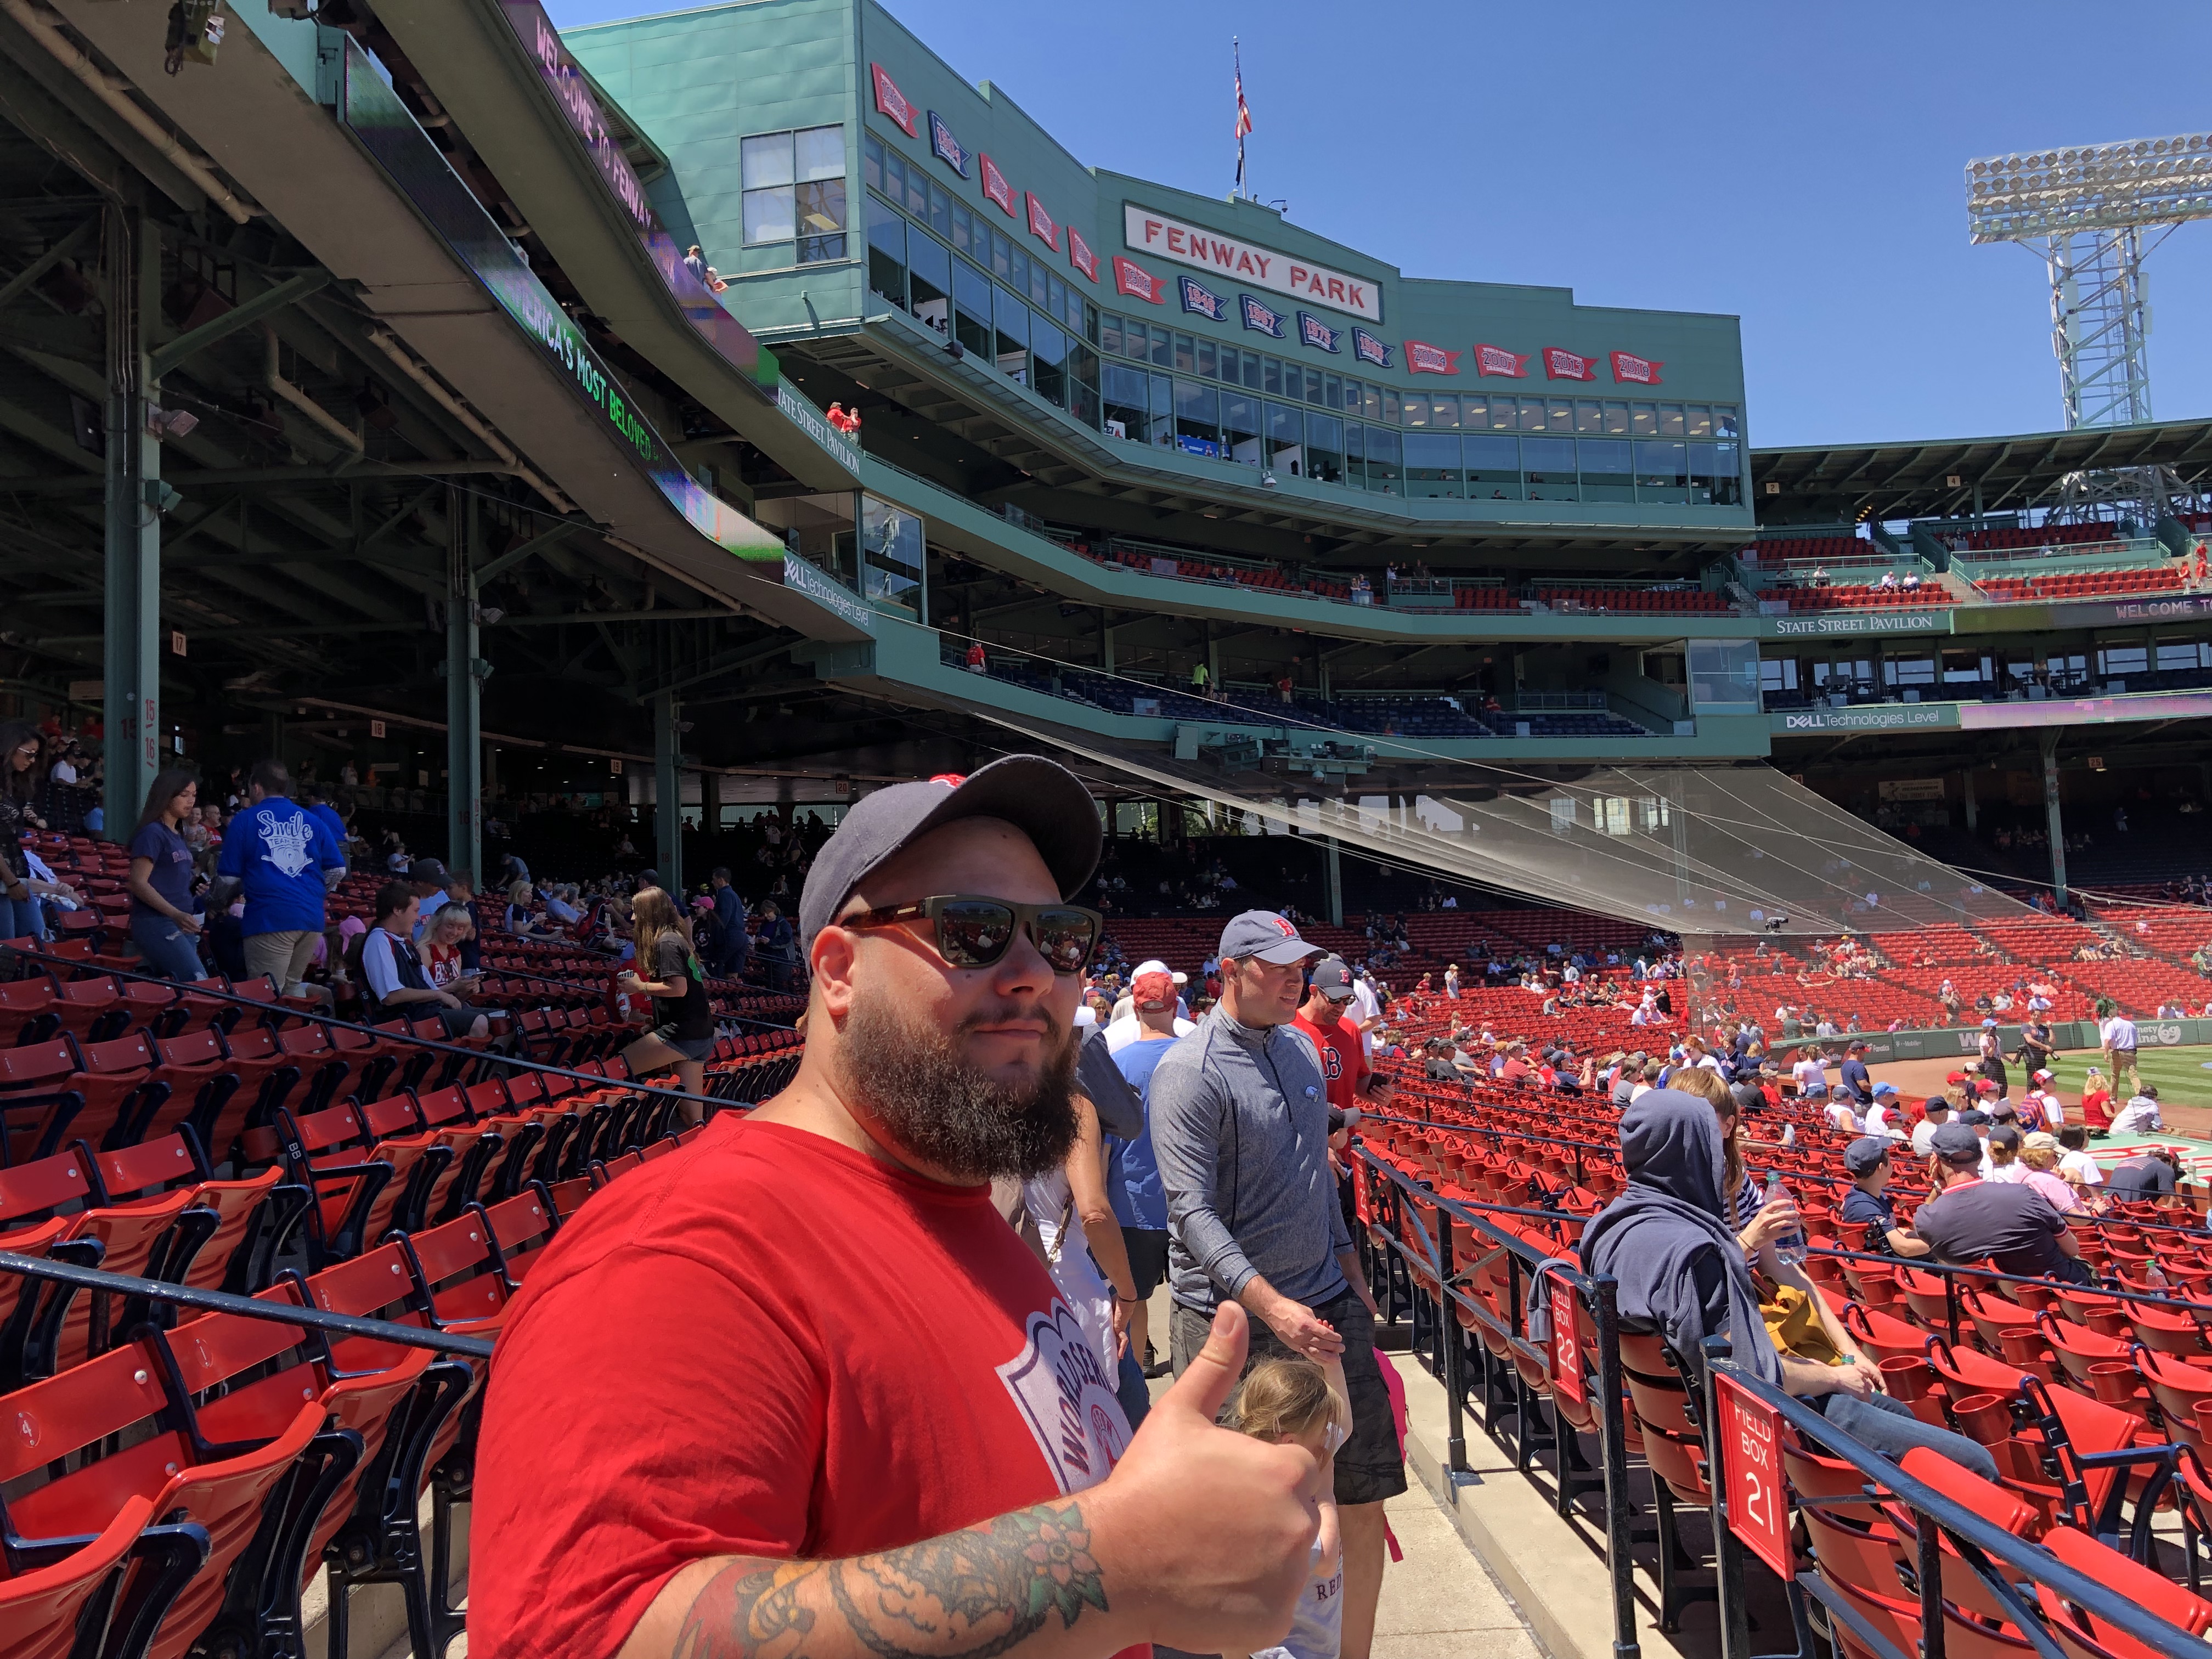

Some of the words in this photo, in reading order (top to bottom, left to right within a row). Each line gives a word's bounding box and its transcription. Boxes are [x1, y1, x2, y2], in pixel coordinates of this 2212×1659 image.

[537, 15, 594, 143] WELCOME
[597, 122, 610, 170] TO
[613, 153, 651, 229] FENWAY
[1146, 219, 1271, 279] FENWAY
[1290, 266, 1365, 309] PARK
[1124, 268, 1151, 293] 1918
[1187, 286, 1216, 312] 1946
[1248, 304, 1274, 329] 1967
[1305, 320, 1331, 345] 1975
[504, 277, 574, 370] MERICA'S
[577, 348, 606, 409] MOST
[610, 388, 651, 461] BELOVED
[1413, 349, 1447, 368] 2004
[1482, 353, 1516, 371] 2007
[1551, 356, 1584, 374] 2013
[1618, 359, 1650, 377] 2018
[778, 387, 797, 420] TATE
[797, 402, 825, 444] STREET
[827, 433, 860, 476] PAVILION
[784, 555, 806, 588] DELL
[805, 569, 851, 616] Technologies
[852, 602, 869, 627] Level
[2116, 600, 2193, 619] WELCOME
[2200, 599, 2212, 612] T
[1776, 620, 1816, 634] STATE
[1818, 618, 1865, 632] STREET
[1870, 616, 1932, 630] PAVILION
[176, 636, 183, 651] 17
[145, 699, 155, 721] 15
[1786, 714, 1825, 728] DELL
[1824, 712, 1904, 728] Technologies
[1908, 710, 1939, 723] Level
[374, 723, 382, 735] 18
[145, 737, 155, 760] 16
[612, 761, 619, 772] 19
[838, 783, 847, 792] 20
[257, 810, 313, 841] Smile
[1272, 918, 1295, 937] B
[1339, 969, 1350, 983] B
[362, 991, 369, 1000] DD
[517, 1025, 524, 1035] CC
[2137, 1034, 2158, 1043] ine
[1321, 1045, 1342, 1080] B
[288, 1142, 302, 1160] BB
[1551, 1286, 1570, 1310] FIELD
[1555, 1306, 1570, 1329] BOX
[1556, 1331, 1577, 1374] 22
[1686, 1374, 1700, 1387] M
[1057, 1349, 1090, 1476] WORLD
[1734, 1400, 1771, 1443] FIELD
[1741, 1431, 1769, 1471] BOX
[1745, 1471, 1774, 1536] 21
[1316, 1573, 1342, 1601] RED
